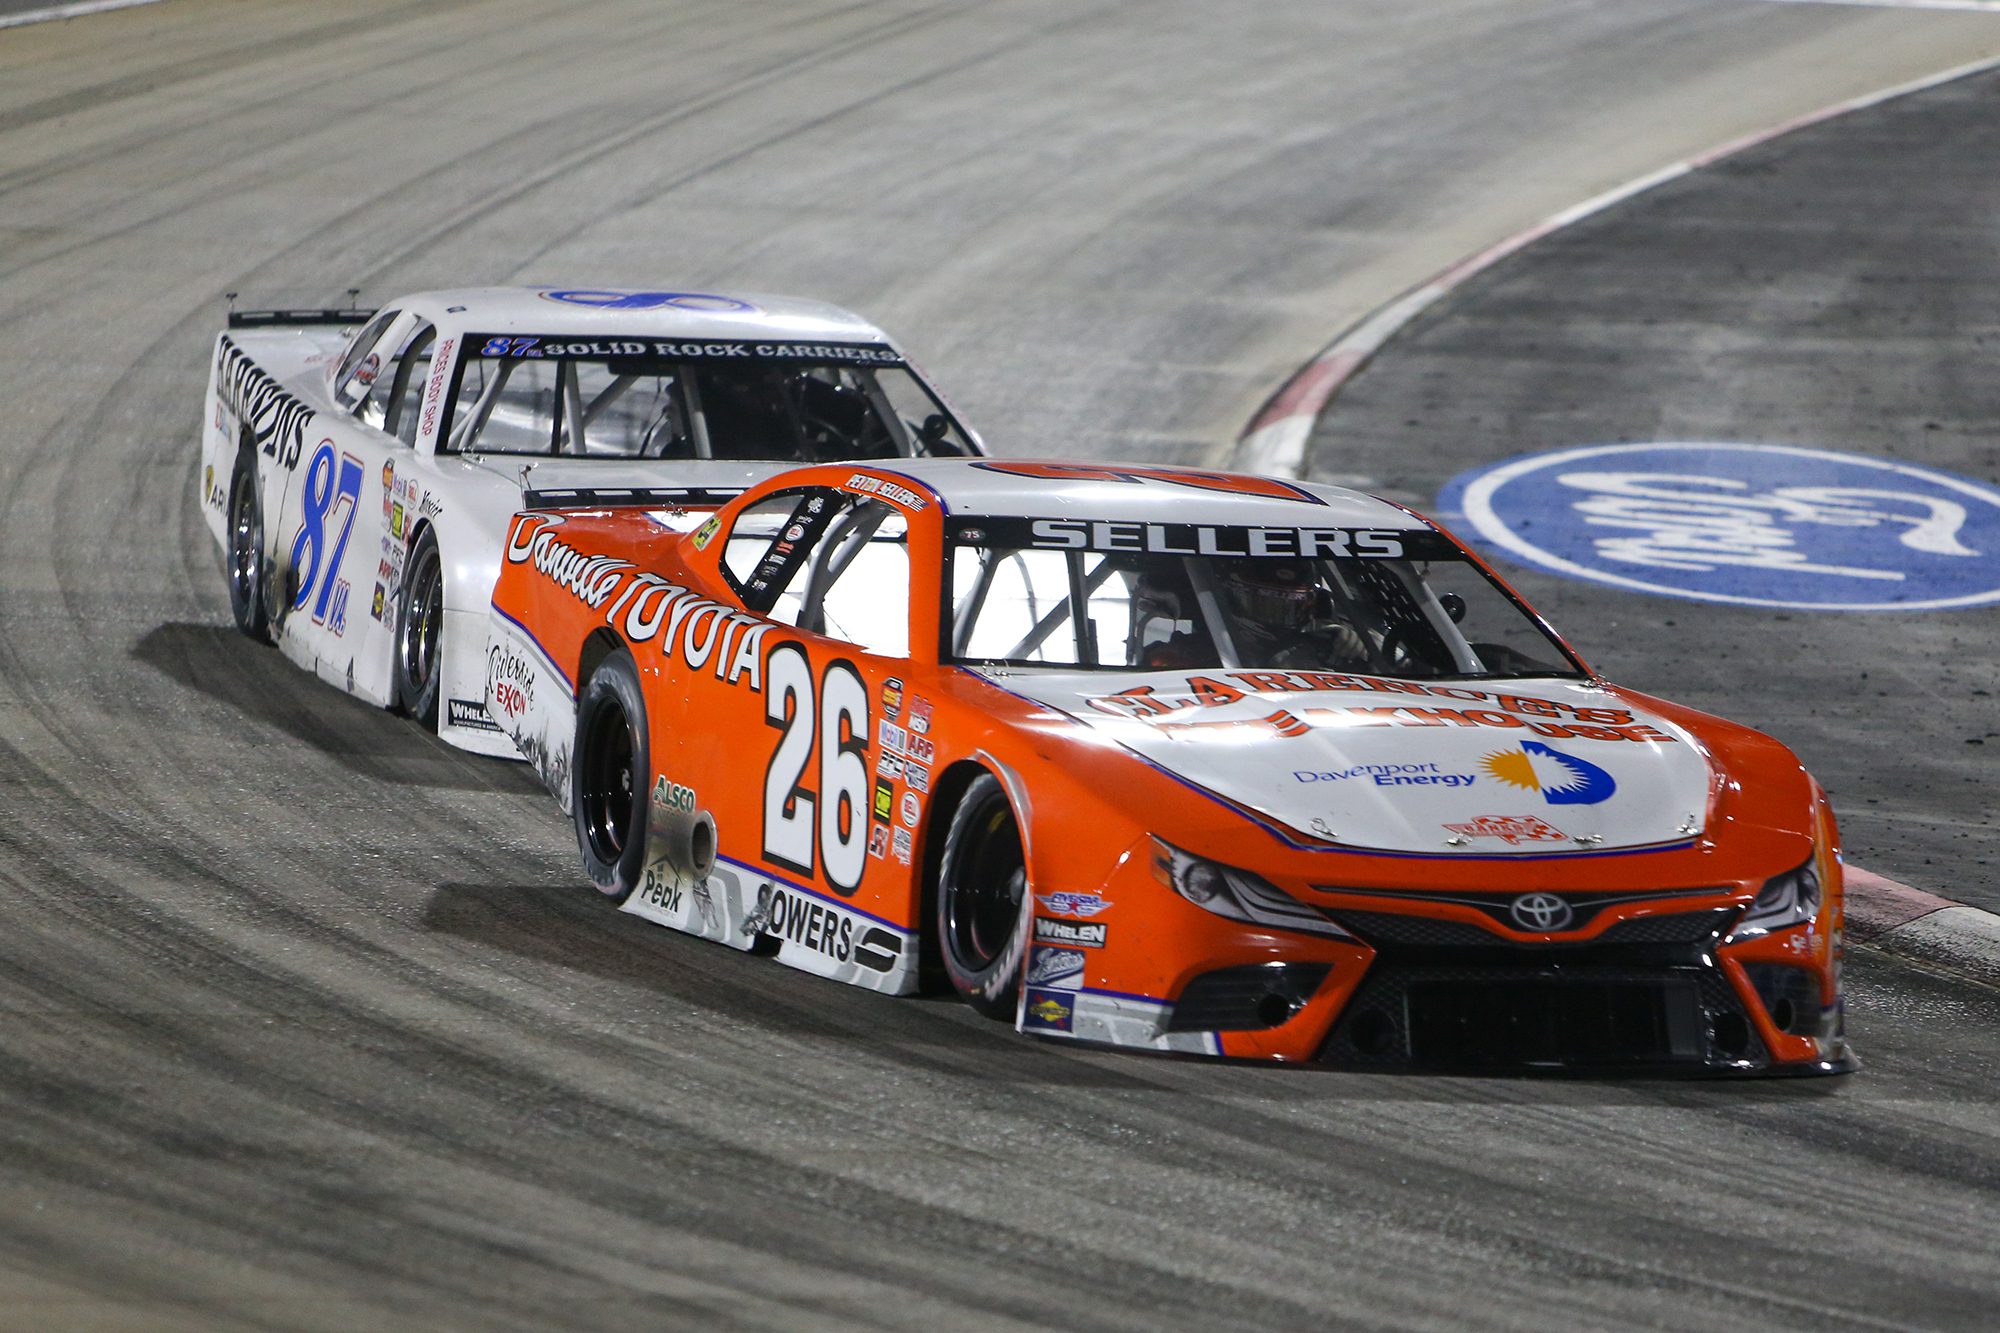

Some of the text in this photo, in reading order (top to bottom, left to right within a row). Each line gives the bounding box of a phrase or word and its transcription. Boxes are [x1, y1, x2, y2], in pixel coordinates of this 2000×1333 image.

[481, 337, 541, 357] 87
[544, 341, 647, 356] SOLID
[653, 342, 750, 357] ROCK
[754, 344, 898, 362] CARRIERS
[421, 405, 436, 436] SHOP
[287, 437, 365, 627] 87
[1031, 519, 1405, 559] SELLERS
[507, 511, 779, 694] Danville TOYOTA
[486, 644, 535, 712] Riverside
[449, 700, 495, 723] WHELE
[496, 681, 527, 718] EXXON
[907, 734, 934, 759] ARP
[761, 640, 870, 898] 26
[1292, 762, 1441, 784] Davenport
[1373, 773, 1477, 787] Energy
[653, 775, 695, 814] ALSCO
[640, 868, 683, 913] Peak
[1035, 916, 1107, 943] WHELEN
